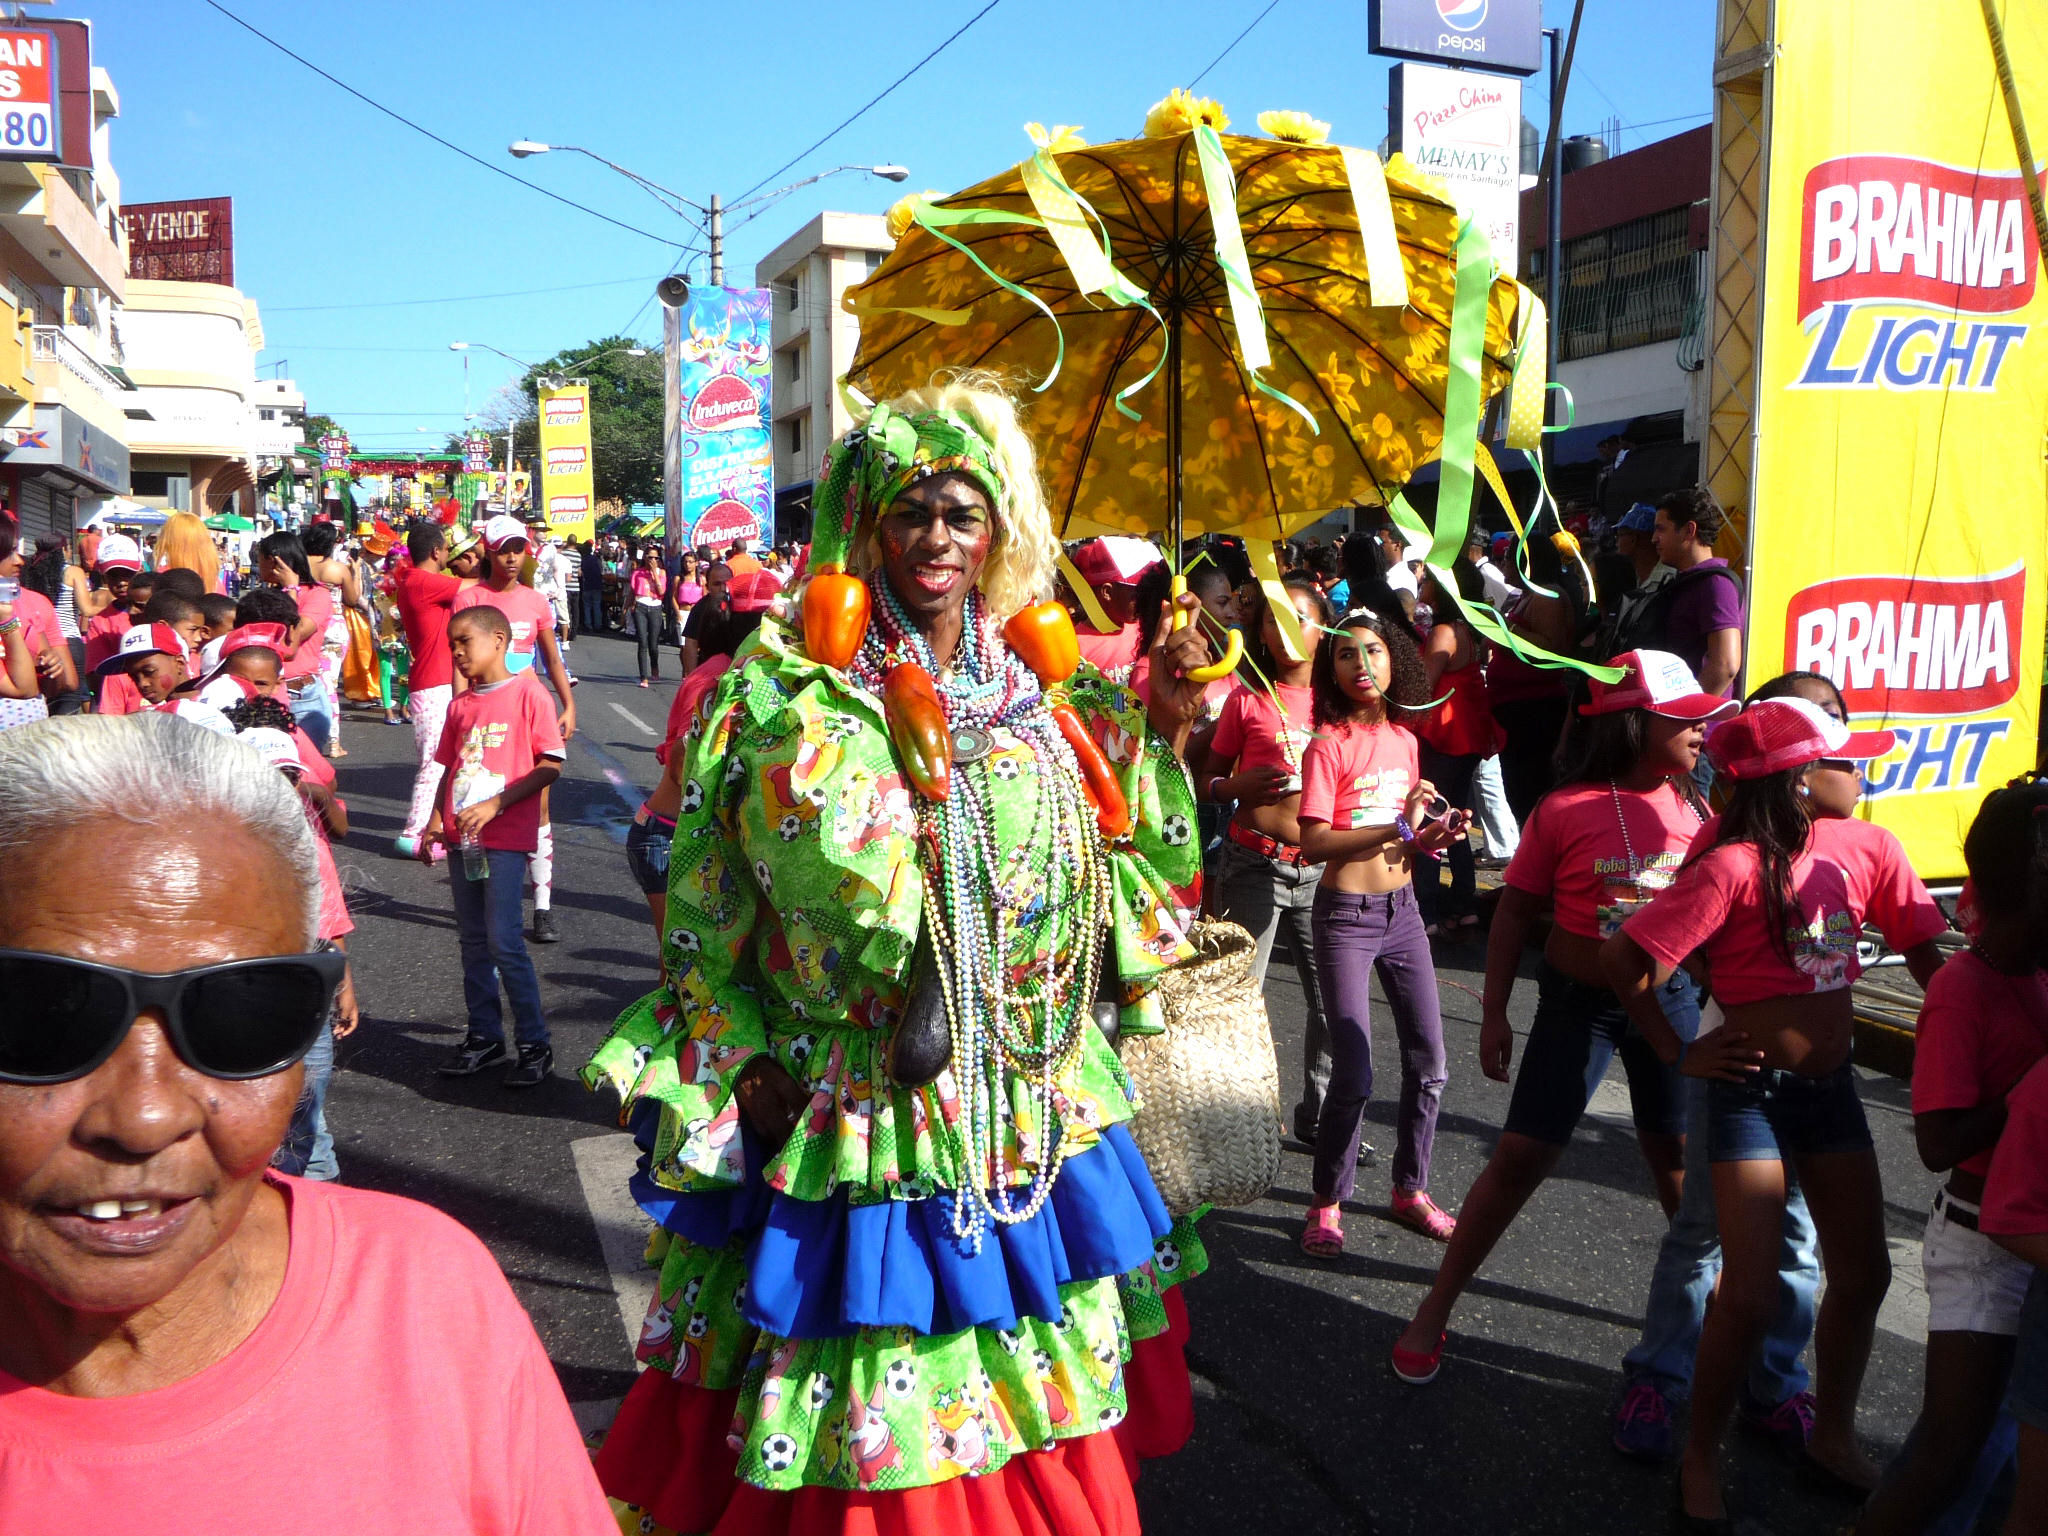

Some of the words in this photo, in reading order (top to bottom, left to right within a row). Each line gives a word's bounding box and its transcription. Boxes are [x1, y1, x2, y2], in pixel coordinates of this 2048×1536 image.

[1438, 33, 1486, 52] pepsi
[0, 111, 48, 147] 80
[1413, 104, 1457, 139] Pizza
[1459, 87, 1502, 109] China
[1416, 145, 1510, 174] MENAY'S
[138, 210, 209, 241] VENDE
[1812, 180, 2026, 289] BRAHMA
[1795, 303, 2029, 388] LIGHT
[694, 399, 755, 421] Induveca
[697, 523, 756, 546] Induveca
[1797, 599, 2010, 690] BRAHMA
[1857, 720, 2011, 795] GHT
[1594, 857, 1627, 875] Roba
